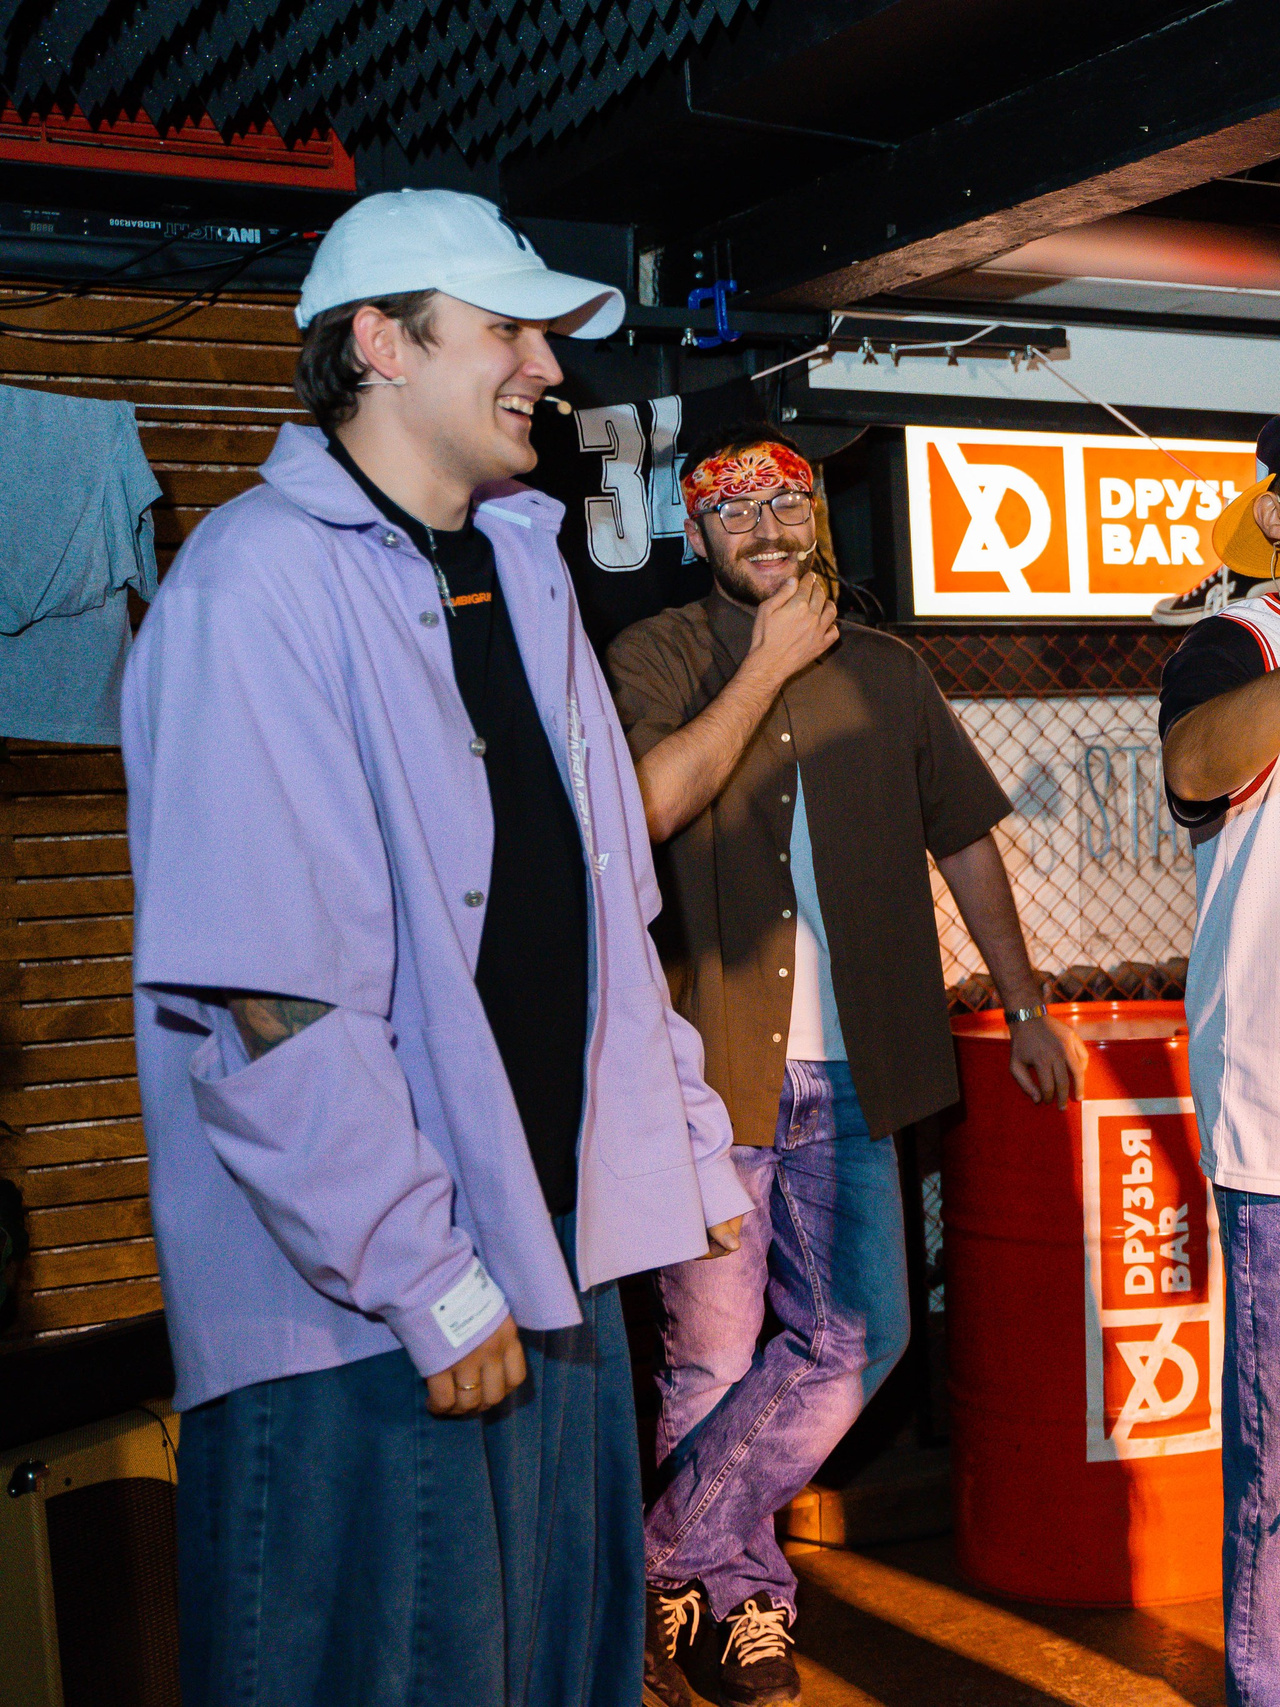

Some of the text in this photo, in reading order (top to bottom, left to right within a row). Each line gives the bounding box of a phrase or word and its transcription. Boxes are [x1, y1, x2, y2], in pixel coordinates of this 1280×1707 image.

[109, 218, 161, 230] LEDBAR308
[1101, 523, 1204, 565] BAR
[1159, 1203, 1192, 1293] BAR
